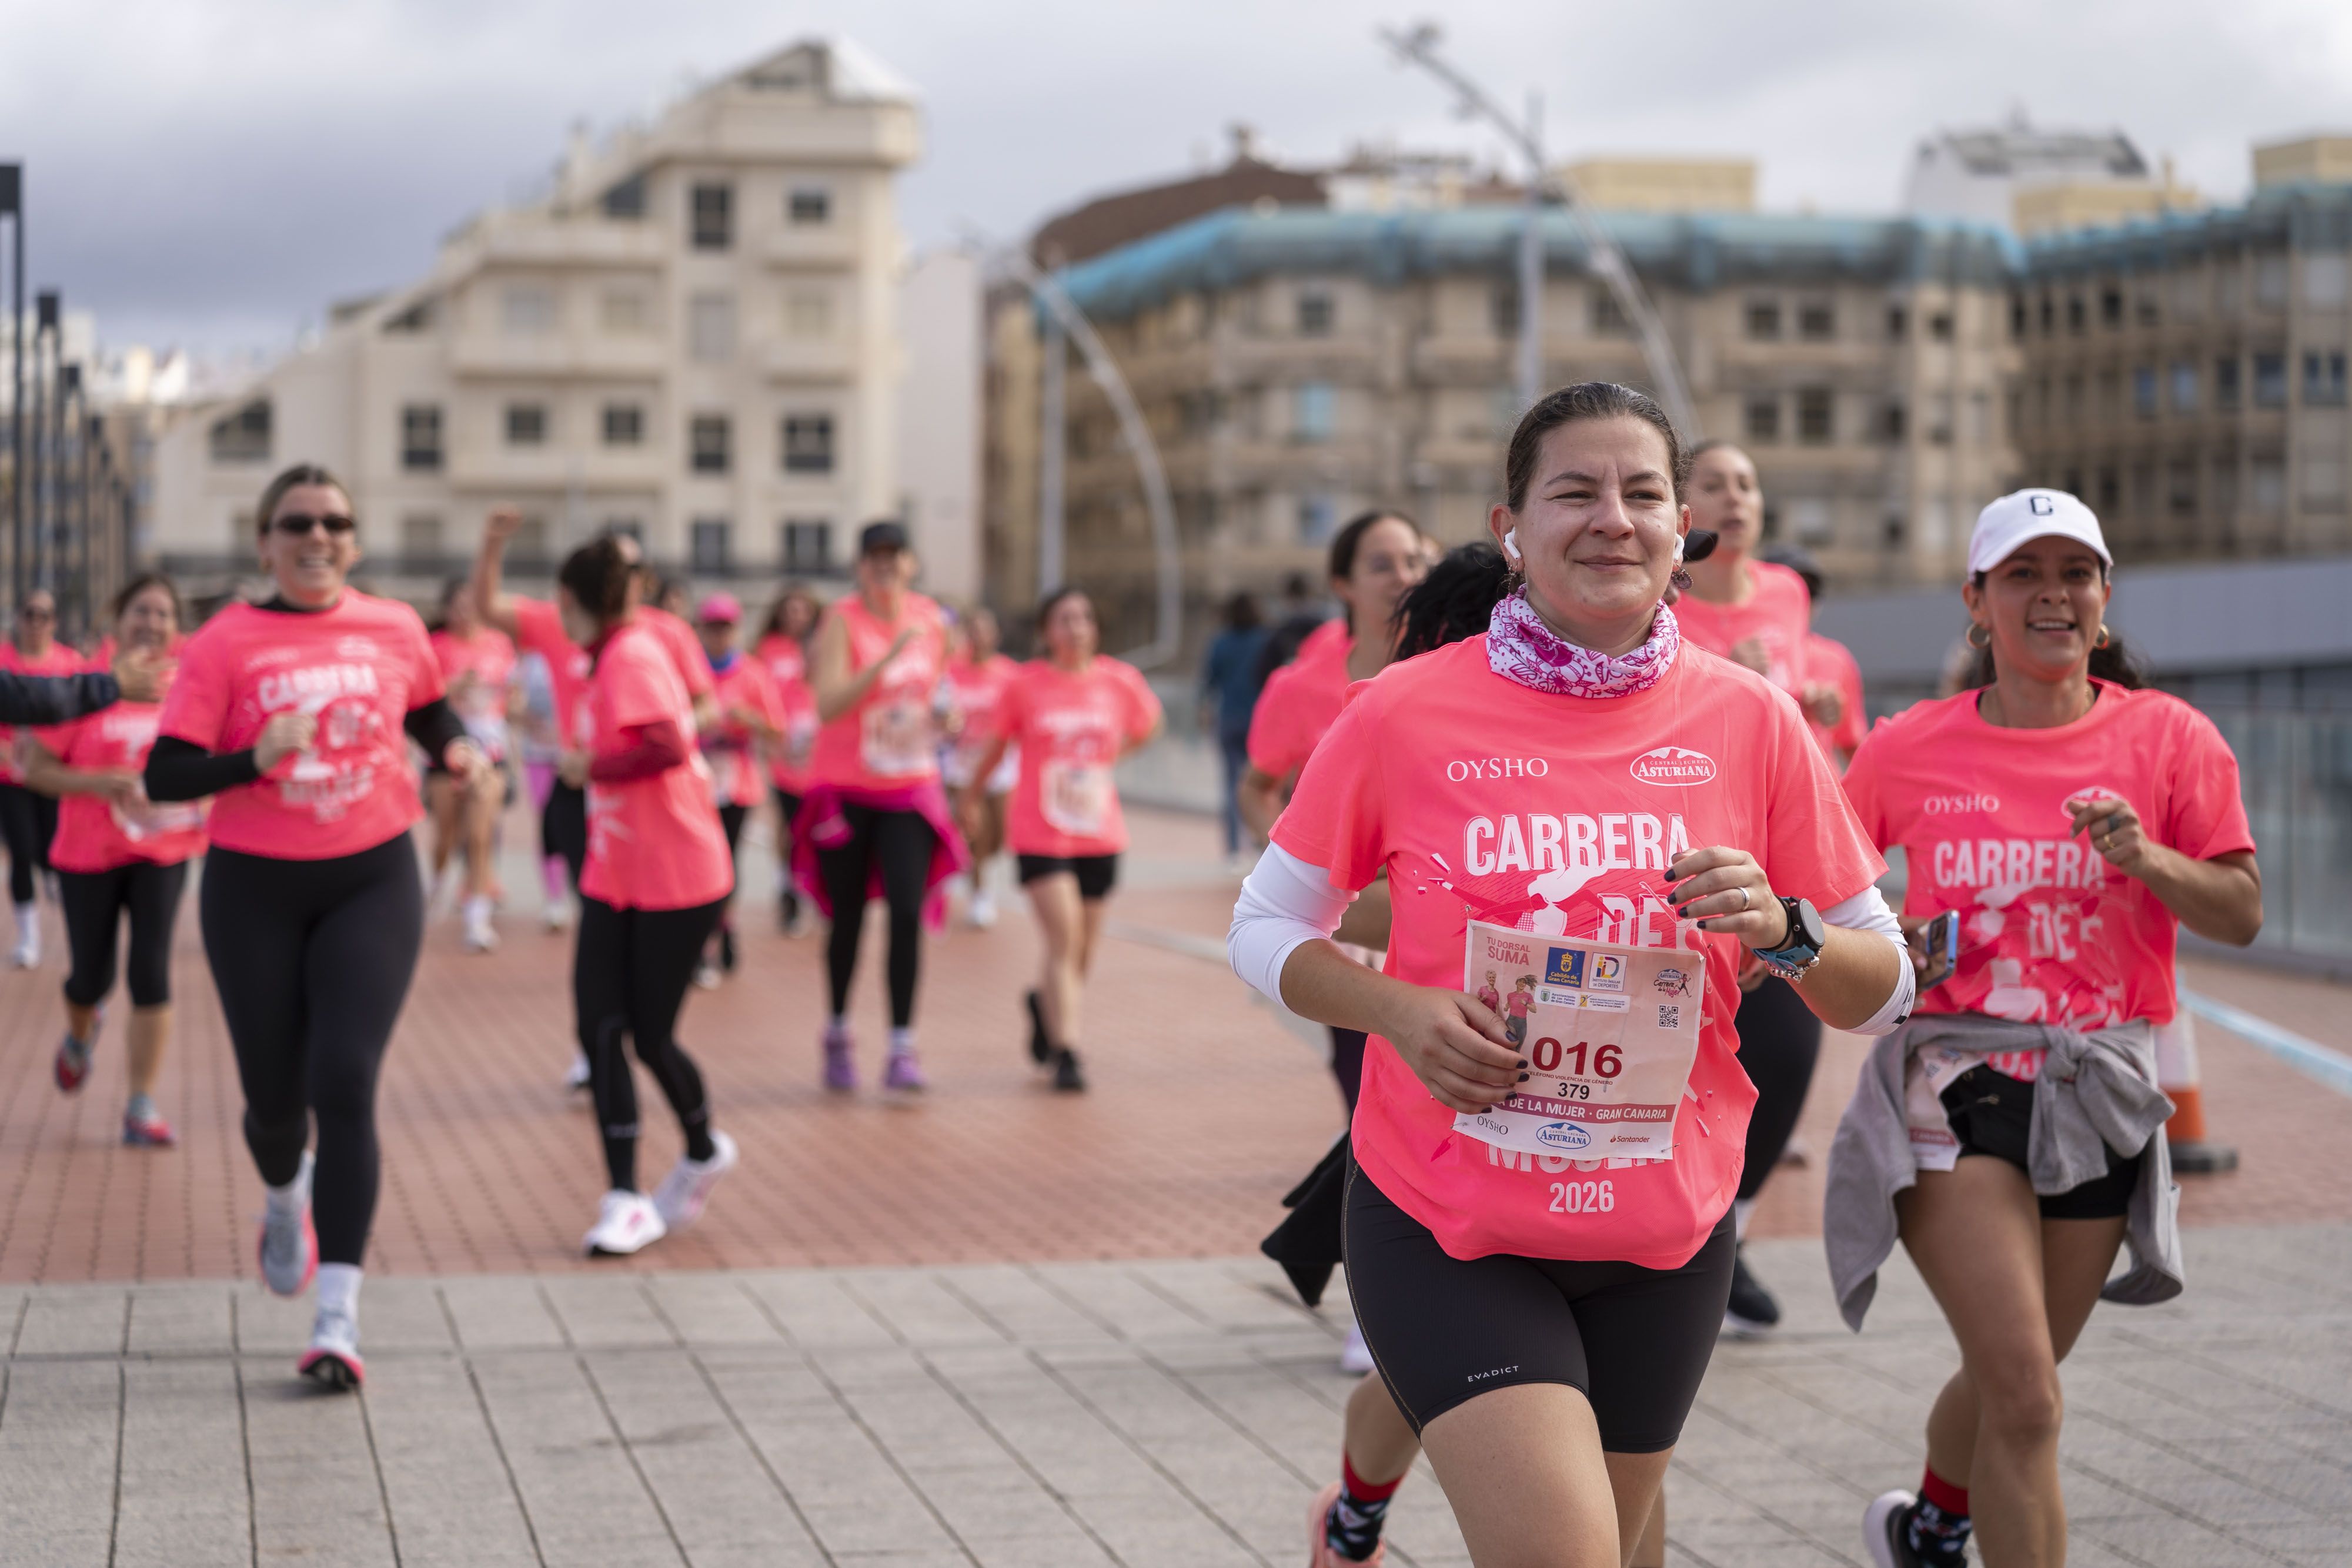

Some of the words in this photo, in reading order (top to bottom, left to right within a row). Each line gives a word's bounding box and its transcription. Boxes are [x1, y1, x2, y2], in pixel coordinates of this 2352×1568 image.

[2030, 495, 2054, 516] C
[1446, 757, 1548, 782] OYSHO
[1638, 761, 1711, 777] ASTURIANA
[1923, 794, 2000, 815] OYSHO
[1464, 813, 1690, 876] CARRERA
[1935, 839, 2105, 889] CARRERA
[2028, 902, 2079, 961] DE
[1486, 936, 1496, 945] TU
[1497, 940, 1531, 952] DORSAL
[1488, 945, 1529, 965] SUMA
[1561, 977, 1580, 985] Canaria
[1532, 1037, 1623, 1079] 016
[1558, 1082, 1590, 1100] 379
[1509, 1098, 1525, 1109] DE
[1528, 1100, 1542, 1112] LA
[1546, 1102, 1586, 1118] MUJER
[1596, 1108, 1622, 1121] GRAN
[1623, 1108, 1667, 1119] CANARIA
[1477, 1115, 1509, 1135] OYSHO
[1540, 1129, 1586, 1145] ASTURIANA
[1617, 1135, 1650, 1144] Santander
[1549, 1179, 1615, 1213] 2026
[1468, 1365, 1519, 1382] EVADICT
